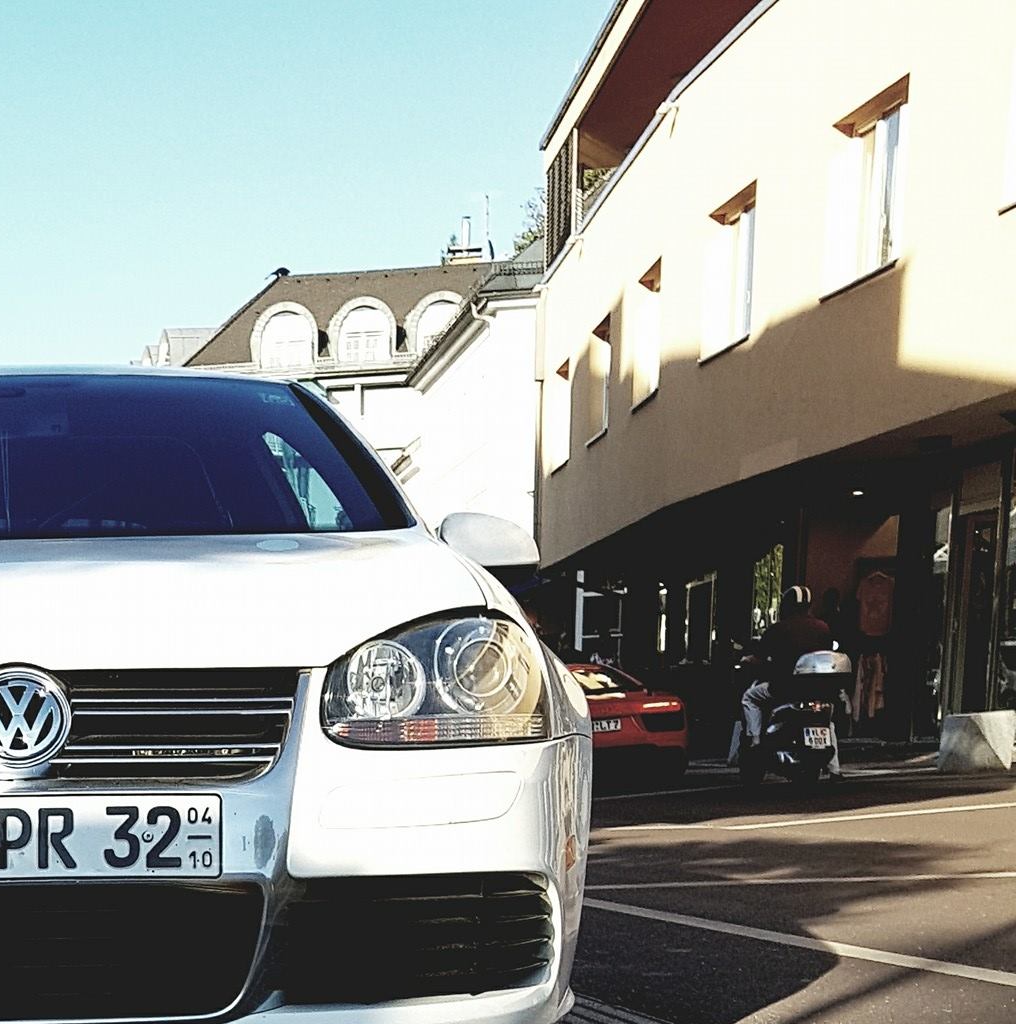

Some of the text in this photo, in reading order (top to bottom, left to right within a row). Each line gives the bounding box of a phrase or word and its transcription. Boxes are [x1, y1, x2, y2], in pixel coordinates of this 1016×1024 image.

[187, 806, 213, 825] 04
[103, 805, 182, 869] 32
[188, 850, 214, 870] 10
